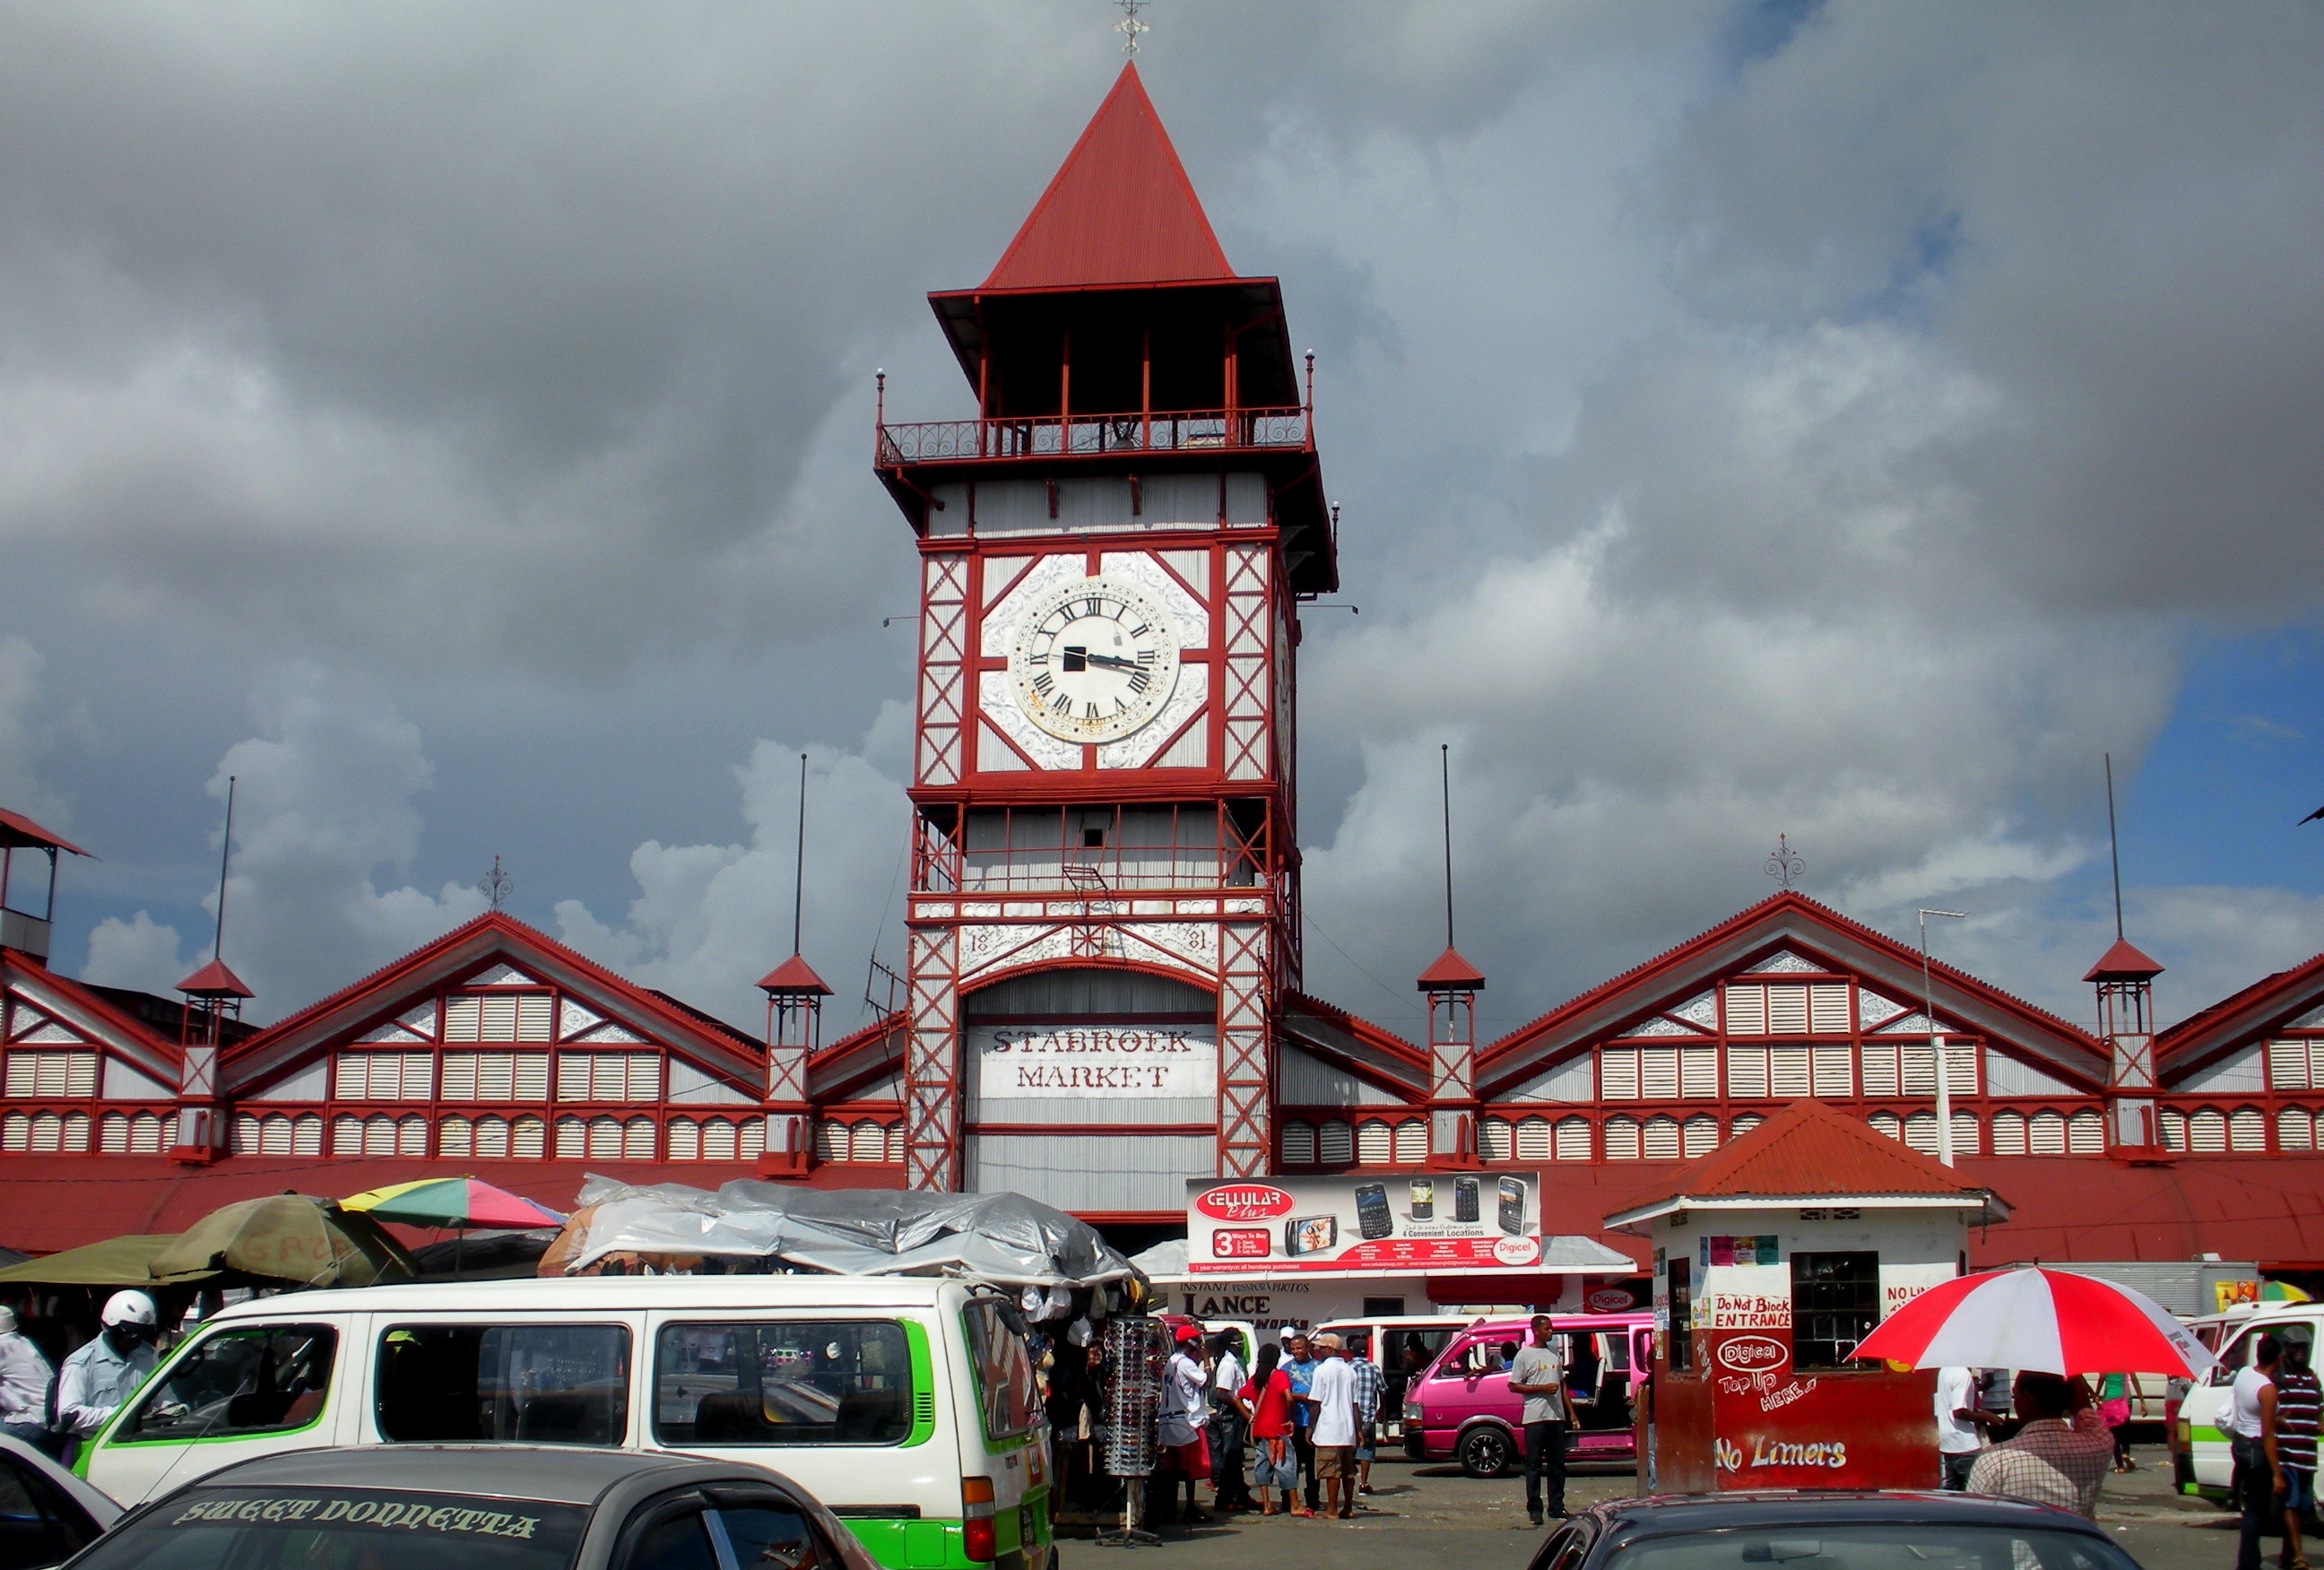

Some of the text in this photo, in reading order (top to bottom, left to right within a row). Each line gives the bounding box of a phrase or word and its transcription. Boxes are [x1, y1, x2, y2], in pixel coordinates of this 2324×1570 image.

[1058, 605, 1077, 625] XI
[1087, 598, 1101, 617] XII
[1115, 605, 1126, 620] I
[1039, 627, 1056, 639] X
[1131, 625, 1149, 638] II
[1030, 654, 1048, 664] IX
[1138, 651, 1155, 664] III
[1033, 672, 1056, 698] VIII
[1054, 693, 1071, 715] VII
[1086, 702, 1099, 718] VI
[972, 934, 987, 952] 18
[993, 1031, 1192, 1053] STABROEK
[1017, 1066, 1169, 1088] MARKET
[1207, 1192, 1281, 1206] CELLULAR
[1226, 1204, 1269, 1218] Plus
[1215, 1231, 1234, 1256] 3
[1499, 1243, 1531, 1253] Digicel
[1180, 1282, 1229, 1291] INSTANT
[1271, 1282, 1310, 1293] PHOTOS
[1887, 1287, 1907, 1300] NO
[1182, 1293, 1270, 1317] LANCE
[1593, 1294, 1628, 1305] Digicel
[1715, 1313, 1791, 1327] ENTRANCE
[1724, 1345, 1776, 1364] Digicel
[1718, 1375, 1751, 1396] Top
[1760, 1381, 1804, 1412] HERE
[1714, 1436, 1847, 1473] No Limers
[173, 1499, 542, 1540] SWEET DONNETTA
